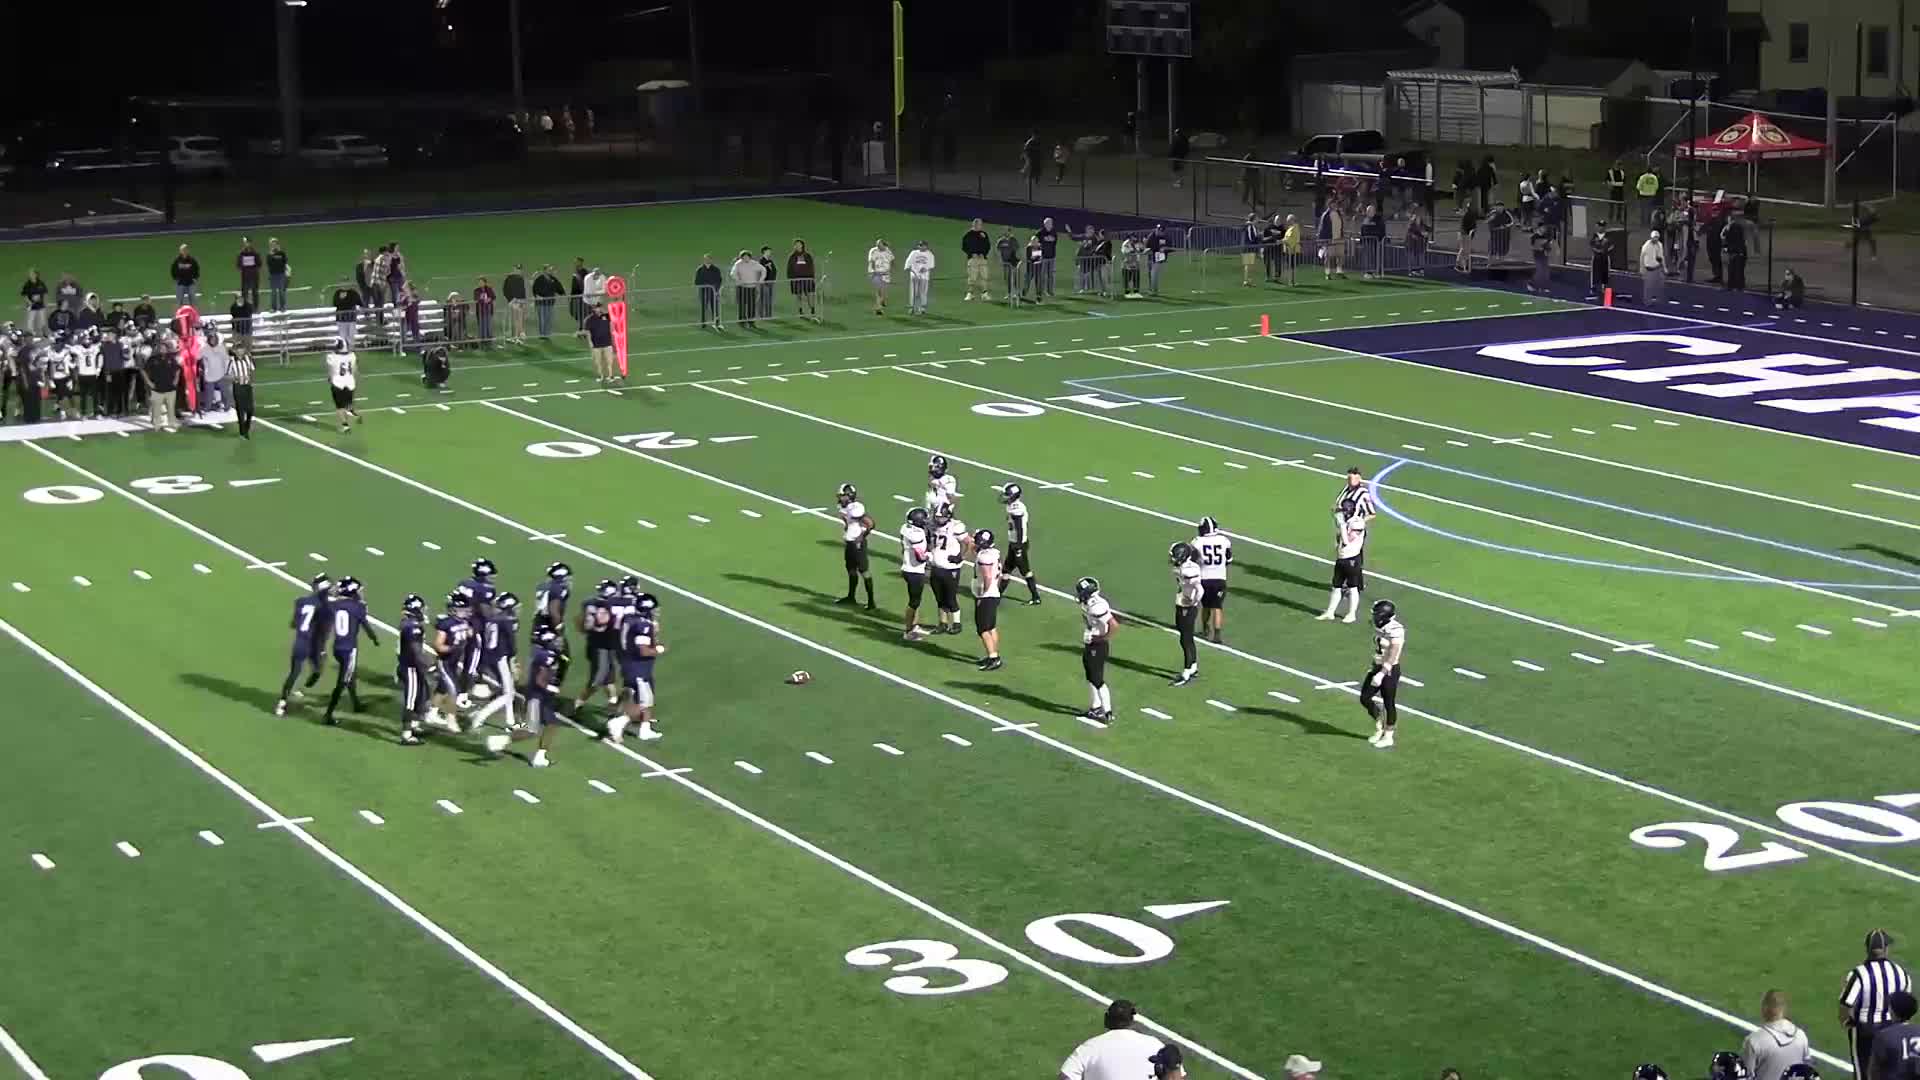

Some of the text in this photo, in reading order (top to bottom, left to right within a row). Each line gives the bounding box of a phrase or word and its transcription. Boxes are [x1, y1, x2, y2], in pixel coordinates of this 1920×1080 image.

[971, 393, 1142, 417] 10
[525, 431, 700, 458] 20
[23, 475, 214, 505] 30
[1202, 544, 1222, 566] 55
[300, 604, 316, 632] 7
[335, 609, 350, 637] 0
[1629, 801, 1920, 872] 20
[844, 912, 1176, 995] 30
